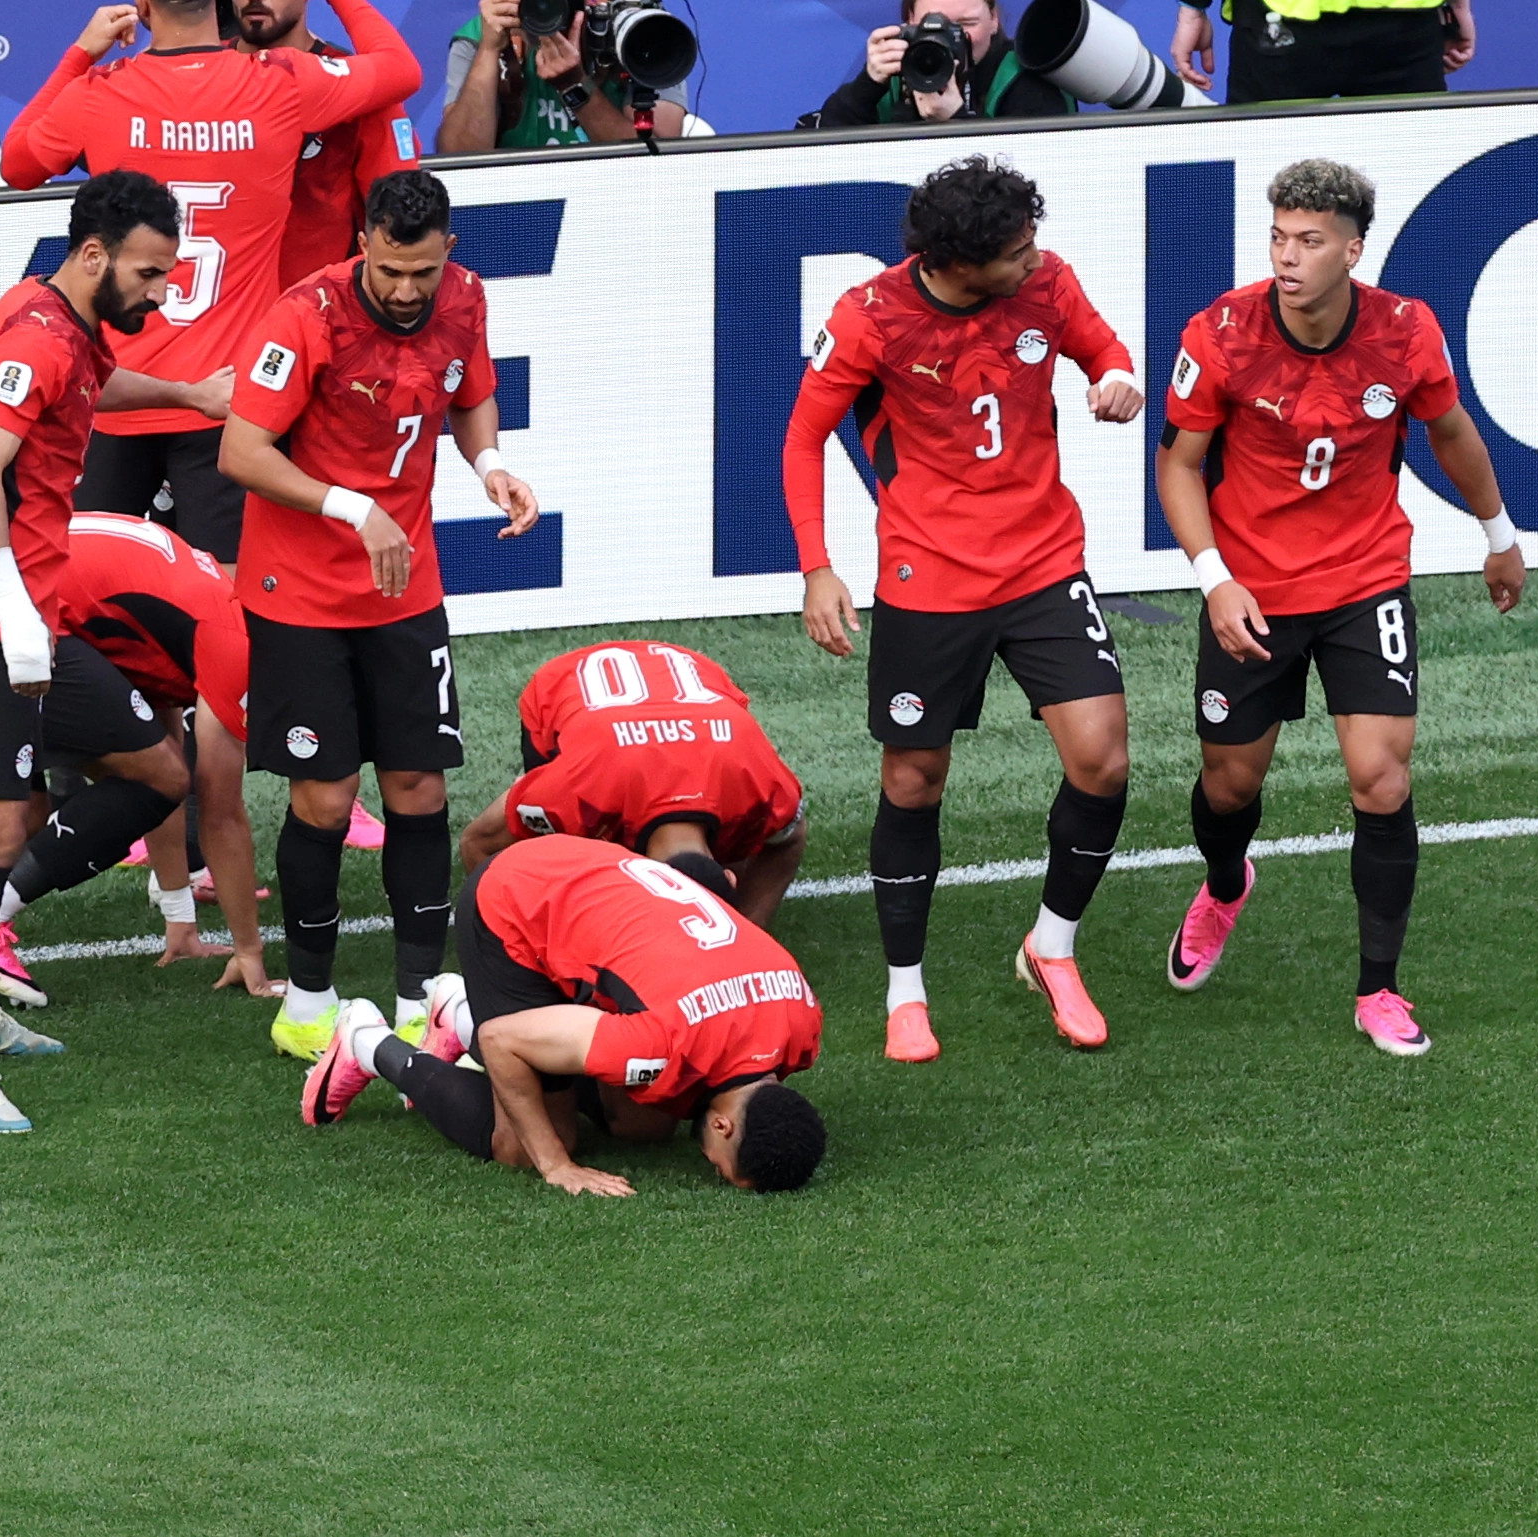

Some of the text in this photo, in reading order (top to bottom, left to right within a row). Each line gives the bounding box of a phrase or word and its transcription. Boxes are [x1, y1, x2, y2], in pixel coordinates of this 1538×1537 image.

[130, 116, 255, 152] R. RABIAA
[165, 181, 235, 327] 5
[389, 414, 423, 479] 7
[971, 392, 1003, 460] 3
[1300, 437, 1336, 491] 8
[1068, 580, 1107, 642] 3
[1376, 599, 1407, 664] 8
[430, 647, 451, 715] 7
[576, 644, 724, 711] 10
[612, 718, 733, 747] M. SALAH
